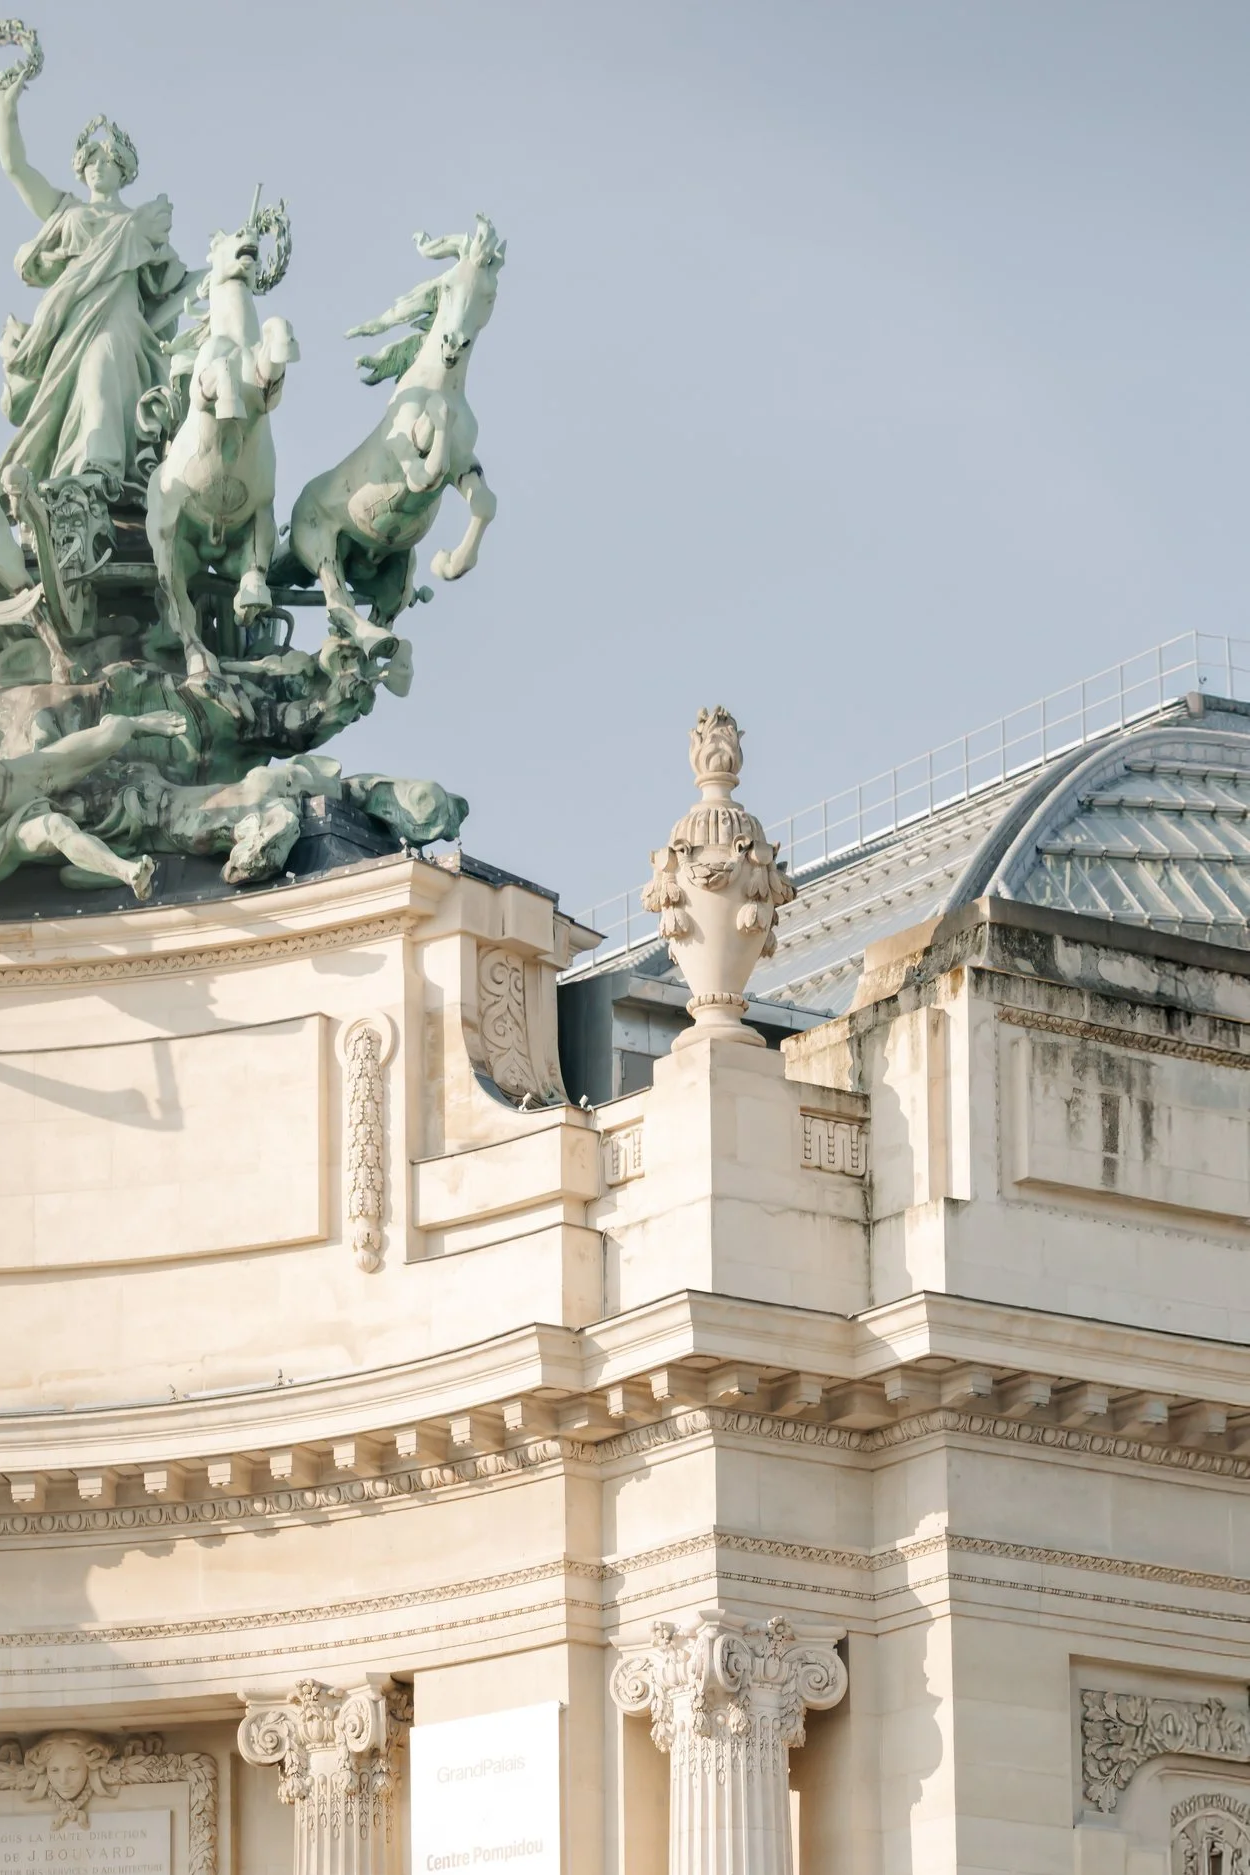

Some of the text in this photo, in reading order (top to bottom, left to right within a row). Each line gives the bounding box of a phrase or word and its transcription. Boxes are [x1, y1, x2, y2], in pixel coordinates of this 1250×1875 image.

[436, 1754, 526, 1784] GrandPalais
[28, 1833, 43, 1843] LA
[49, 1832, 83, 1842] HAUTE
[89, 1829, 148, 1841] DIRECTION
[3, 1853, 20, 1863] DE
[44, 1846, 137, 1862] BOUVARD
[426, 1837, 544, 1872] Centre Pompidou
